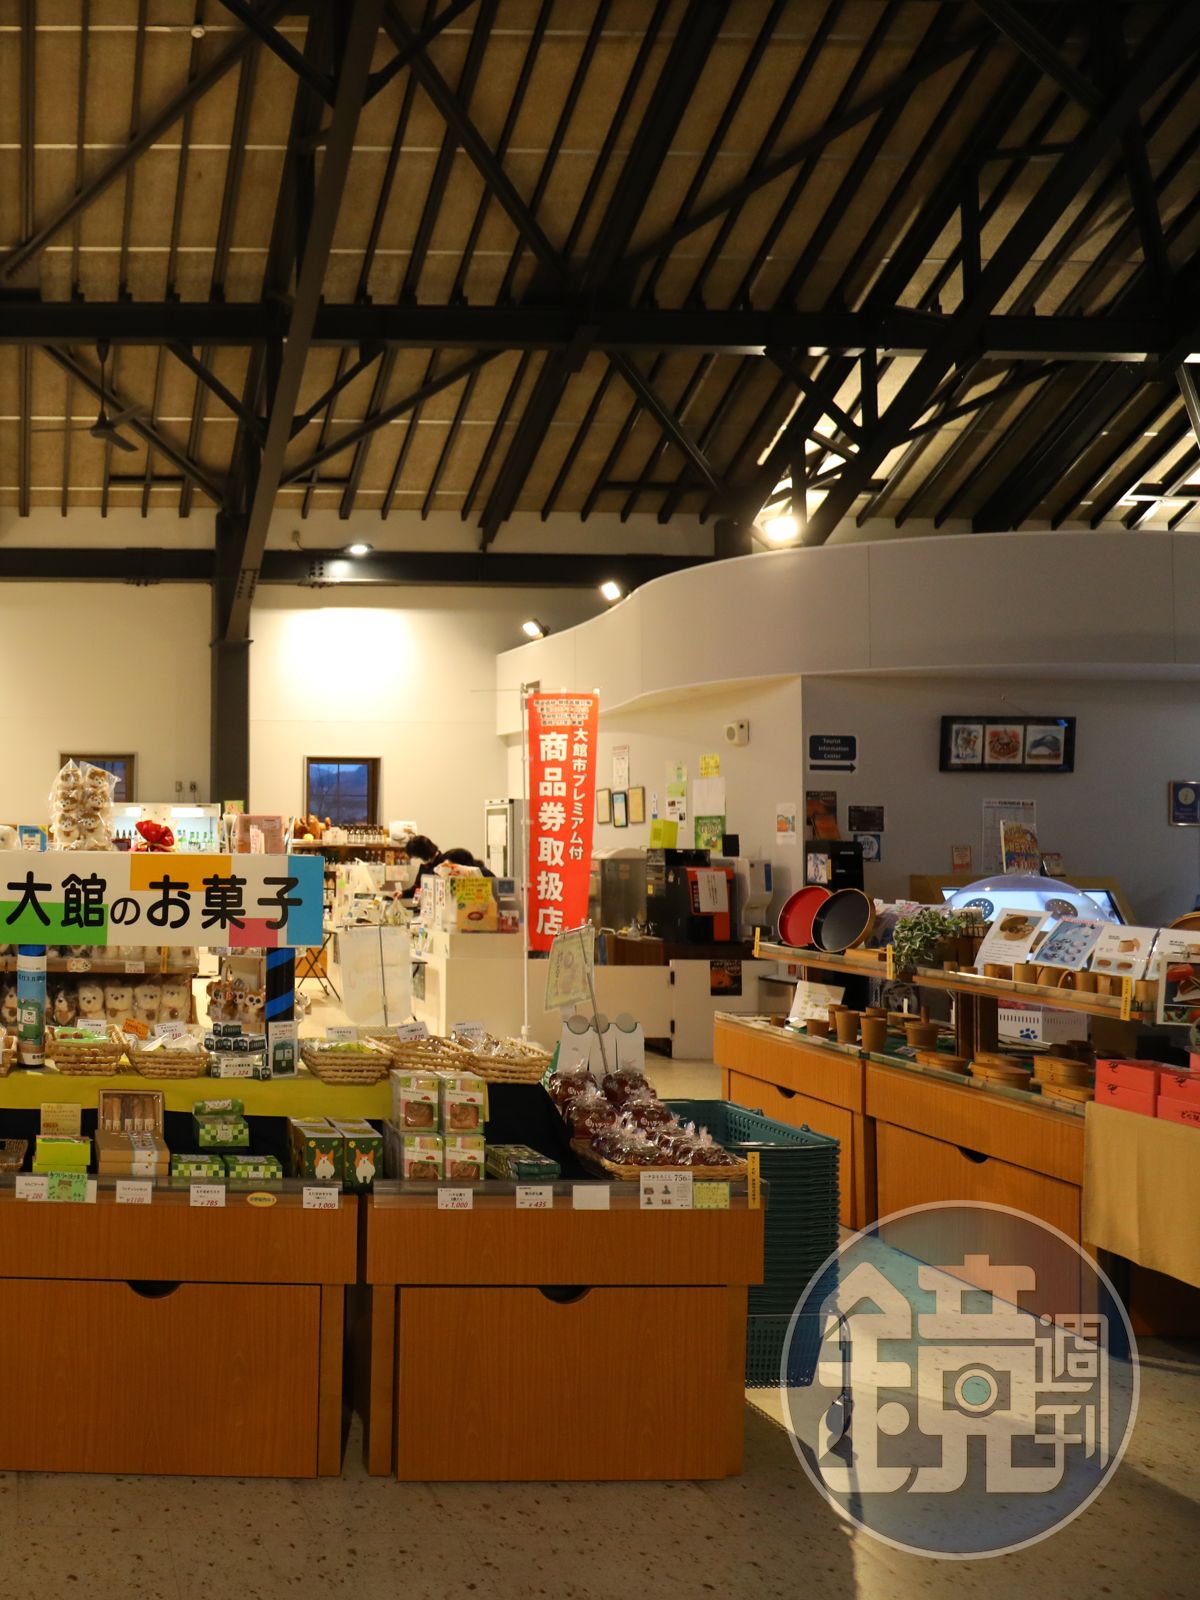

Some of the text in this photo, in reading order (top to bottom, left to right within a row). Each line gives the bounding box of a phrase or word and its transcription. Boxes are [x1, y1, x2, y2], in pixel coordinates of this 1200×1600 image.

[536, 731, 569, 936] 商品券取扱店
[569, 728, 589, 860] 大館市プレミアム付
[5, 870, 304, 930] 大館のお菓子
